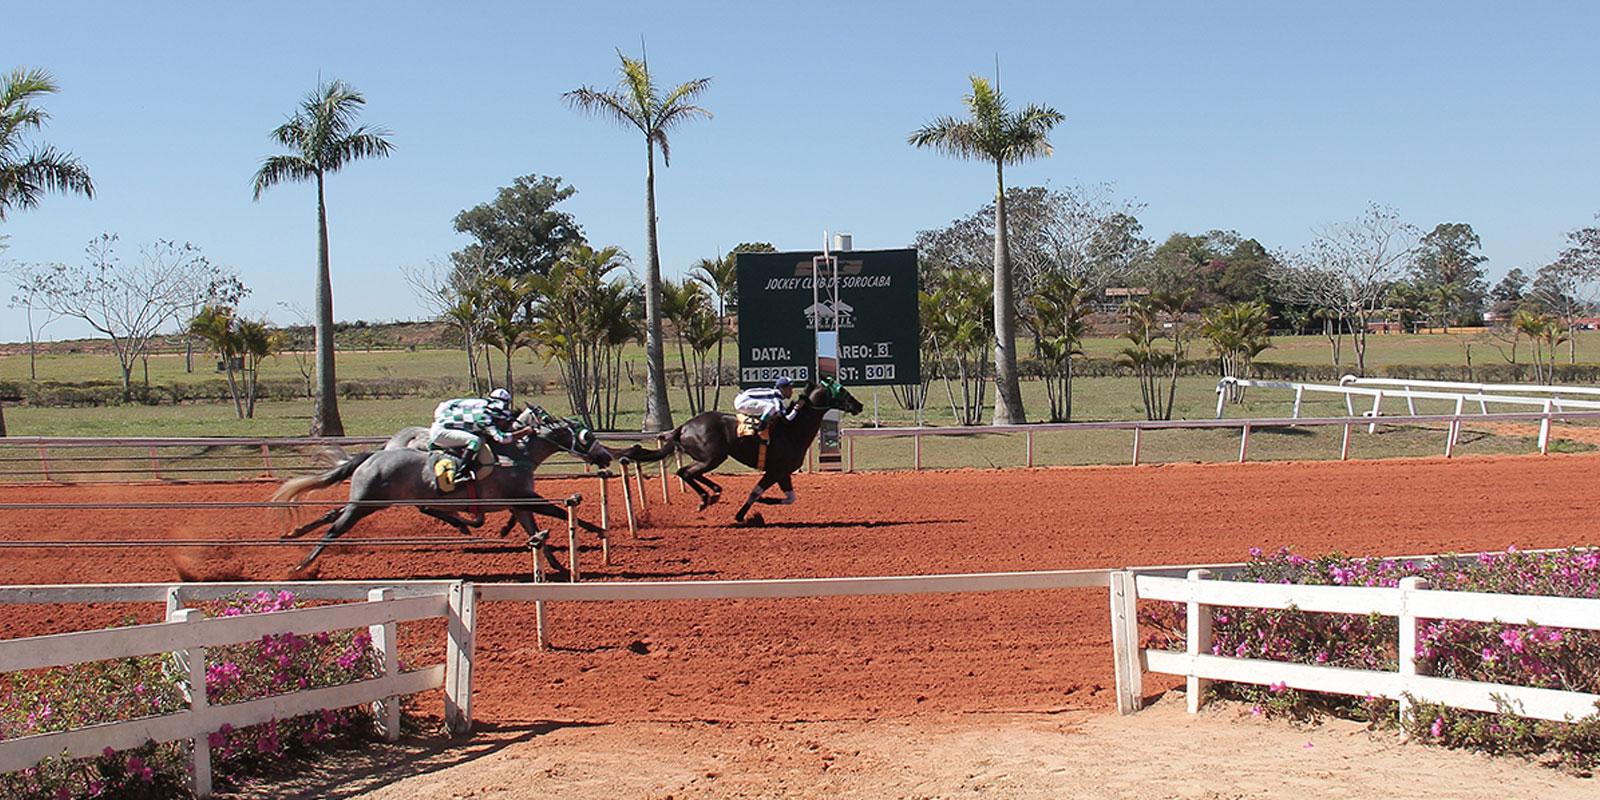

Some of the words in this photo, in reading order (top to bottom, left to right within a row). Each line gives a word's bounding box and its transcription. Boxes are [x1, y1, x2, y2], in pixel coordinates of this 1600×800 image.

[764, 277, 800, 290] JOCKEY
[843, 275, 891, 288] SOROCABA
[752, 347, 791, 361] DATA:
[879, 344, 887, 355] 3
[866, 366, 894, 379] 301
